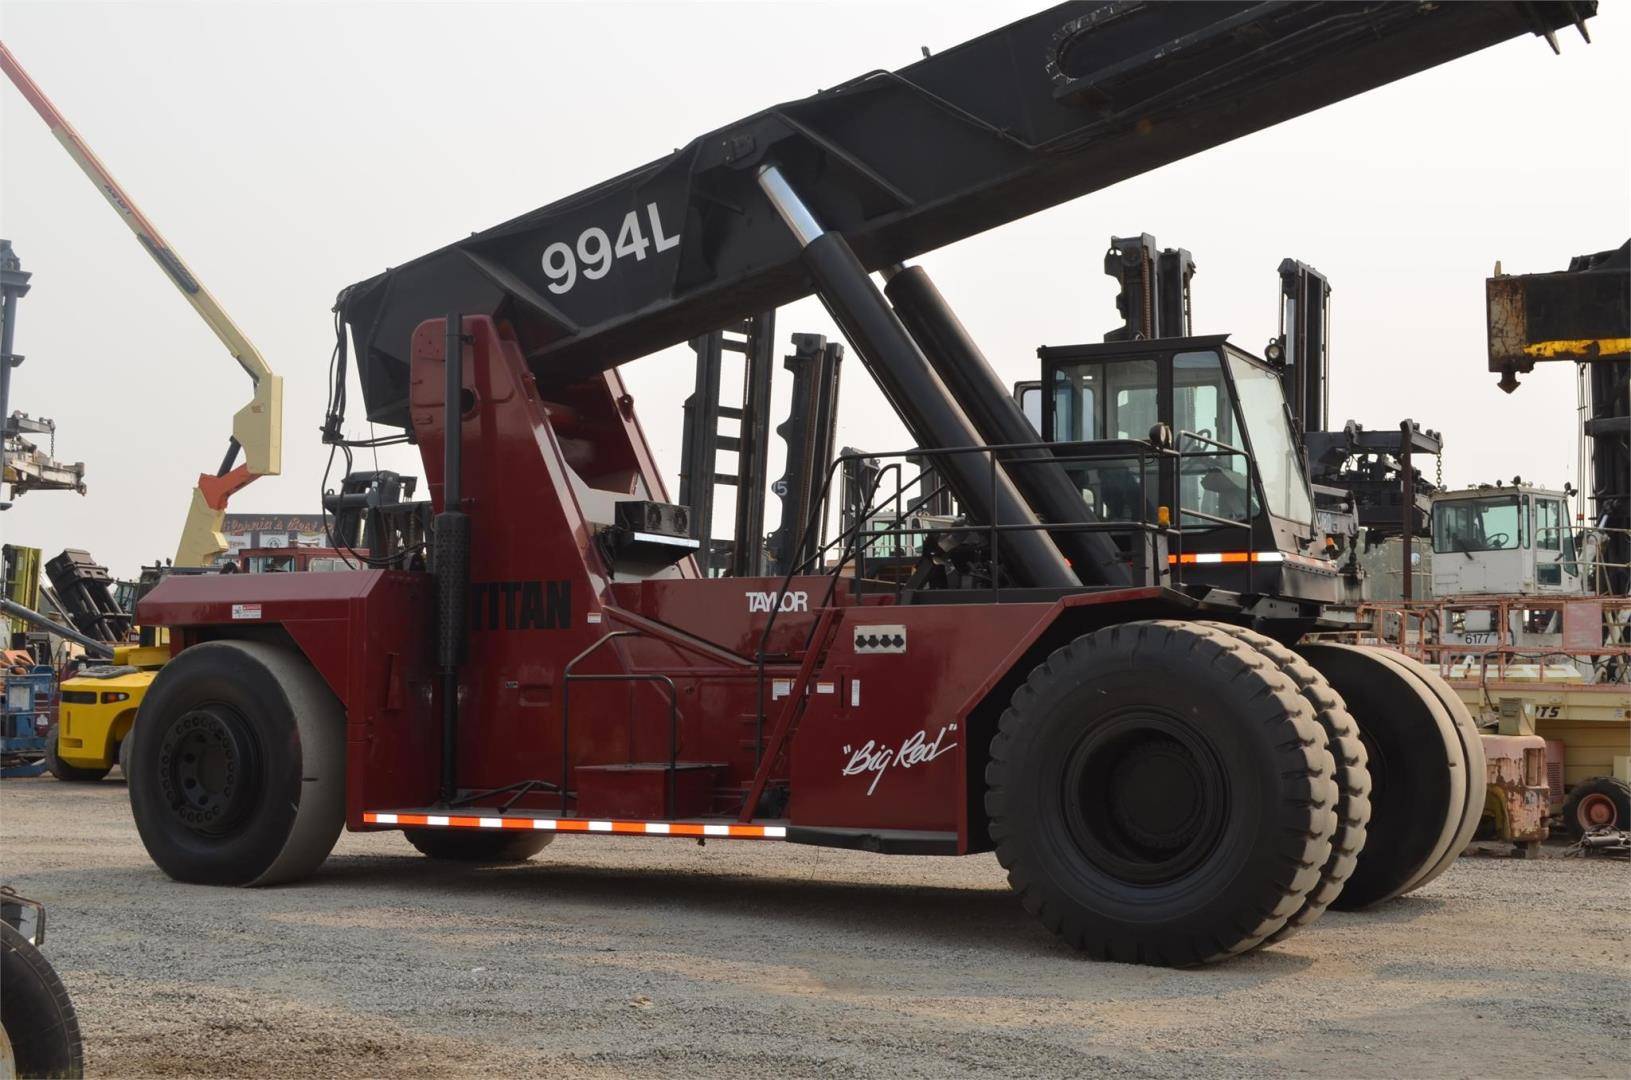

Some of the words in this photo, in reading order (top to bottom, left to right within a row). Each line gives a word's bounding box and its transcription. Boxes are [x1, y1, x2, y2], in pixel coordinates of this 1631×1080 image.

[542, 202, 681, 295] 994L
[472, 581, 571, 629] TITAN
[746, 592, 808, 612] TAYLOR
[1466, 633, 1490, 645] 6177
